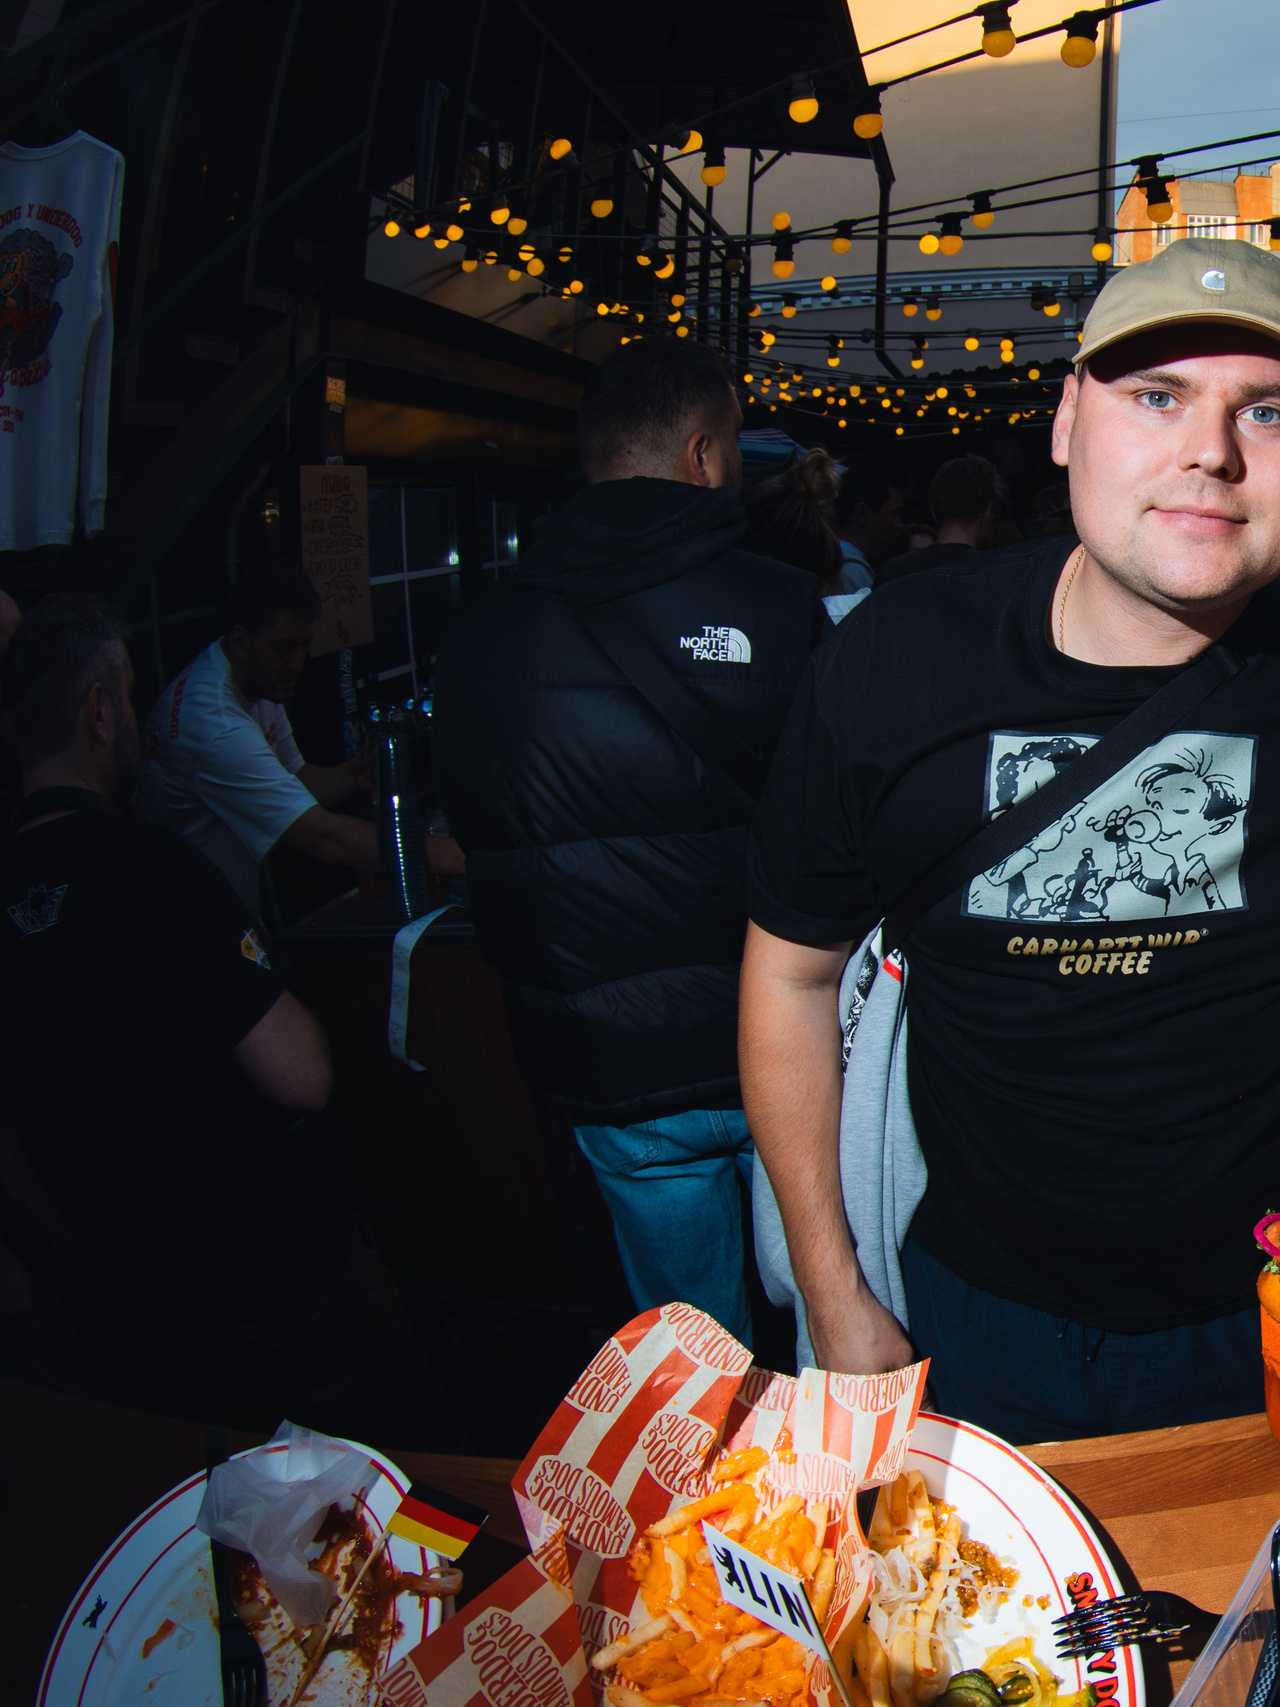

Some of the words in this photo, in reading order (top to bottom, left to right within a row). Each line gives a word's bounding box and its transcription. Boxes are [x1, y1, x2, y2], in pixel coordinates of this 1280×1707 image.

[26, 203, 34, 218] X
[37, 204, 84, 249] UNDERDOG
[321, 474, 350, 494] ПИВО
[679, 636, 728, 650] NORTH
[702, 625, 730, 639] THE
[693, 648, 728, 662] FACE
[1058, 950, 1154, 976] COFFEE
[663, 1303, 748, 1372] UNDERDOG
[836, 1368, 916, 1412] UNDERDOG
[653, 1413, 702, 1450] DOGS
[538, 1459, 583, 1499] DOGS
[803, 1453, 856, 1492] FAMOUS
[529, 1475, 625, 1555] UNDERDOG
[576, 1475, 631, 1539] FAMOUS
[484, 1612, 536, 1660] DOGS
[1067, 1572, 1117, 1674] SMY
